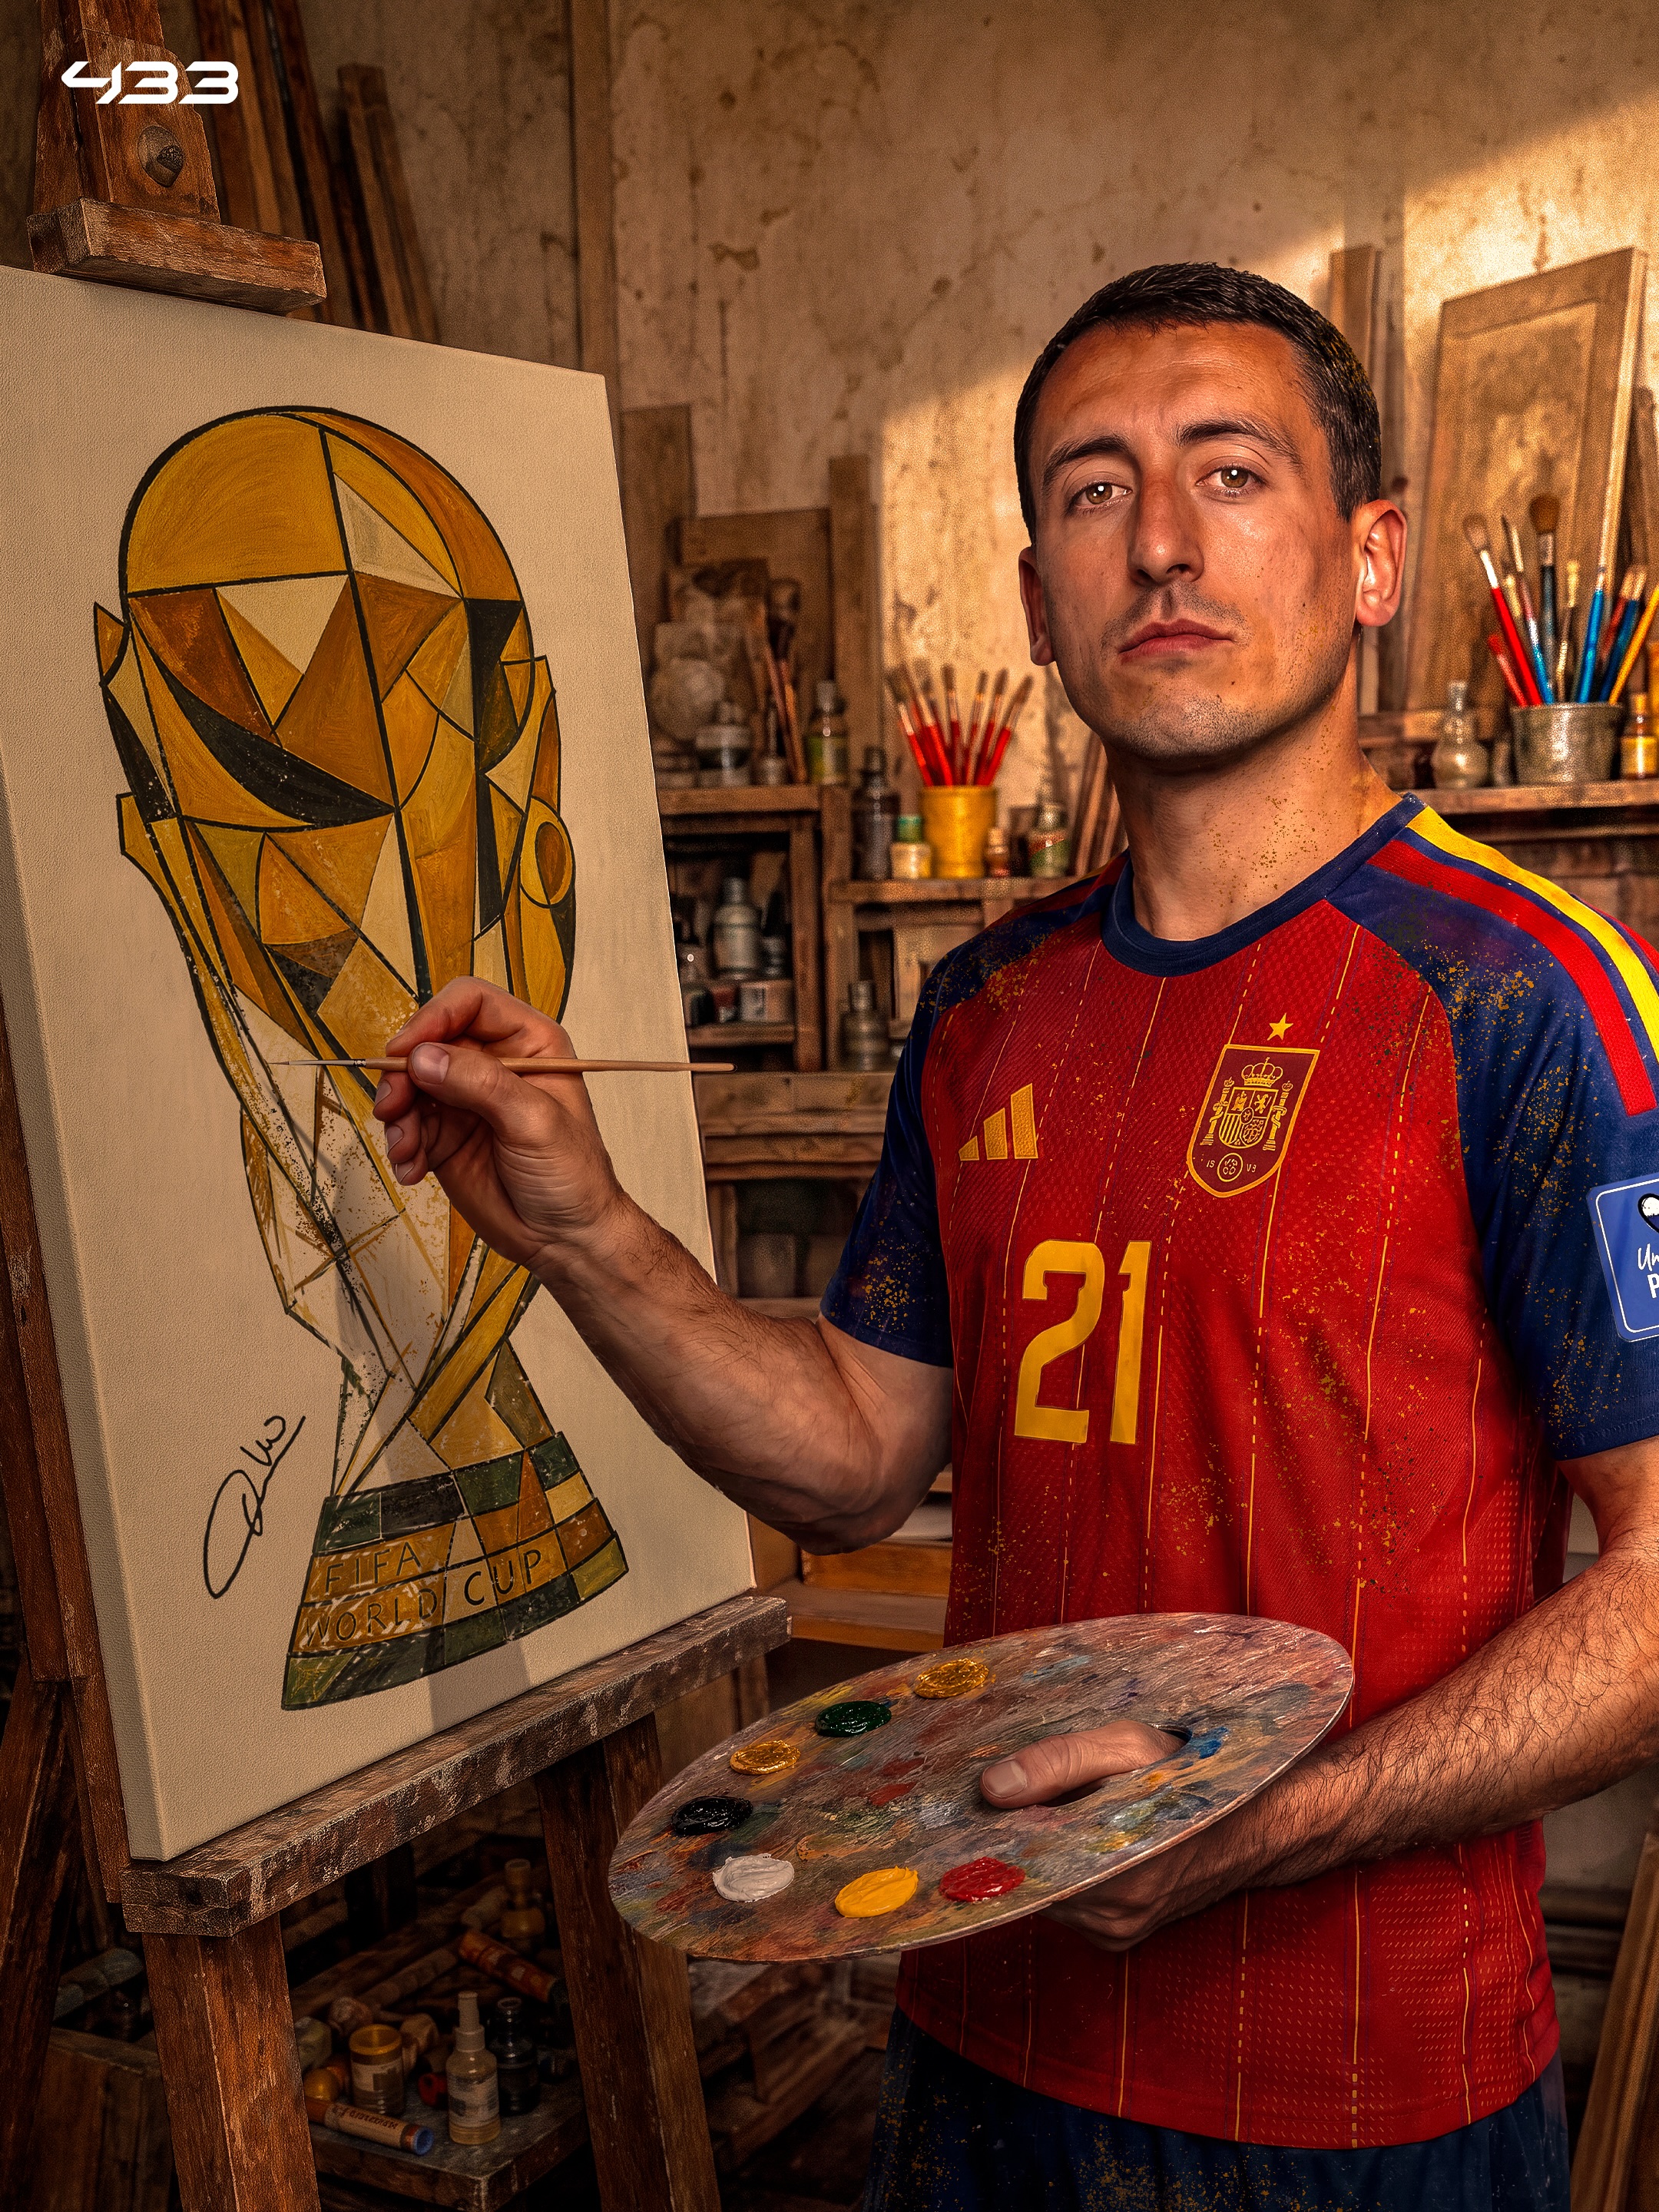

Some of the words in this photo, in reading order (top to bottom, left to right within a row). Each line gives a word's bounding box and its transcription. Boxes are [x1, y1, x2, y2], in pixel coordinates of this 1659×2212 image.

[1015, 1239, 1151, 1445] 21
[306, 1587, 438, 1647] WORLD
[464, 1549, 541, 1606] CUP
[325, 1541, 422, 1596] FIFA
